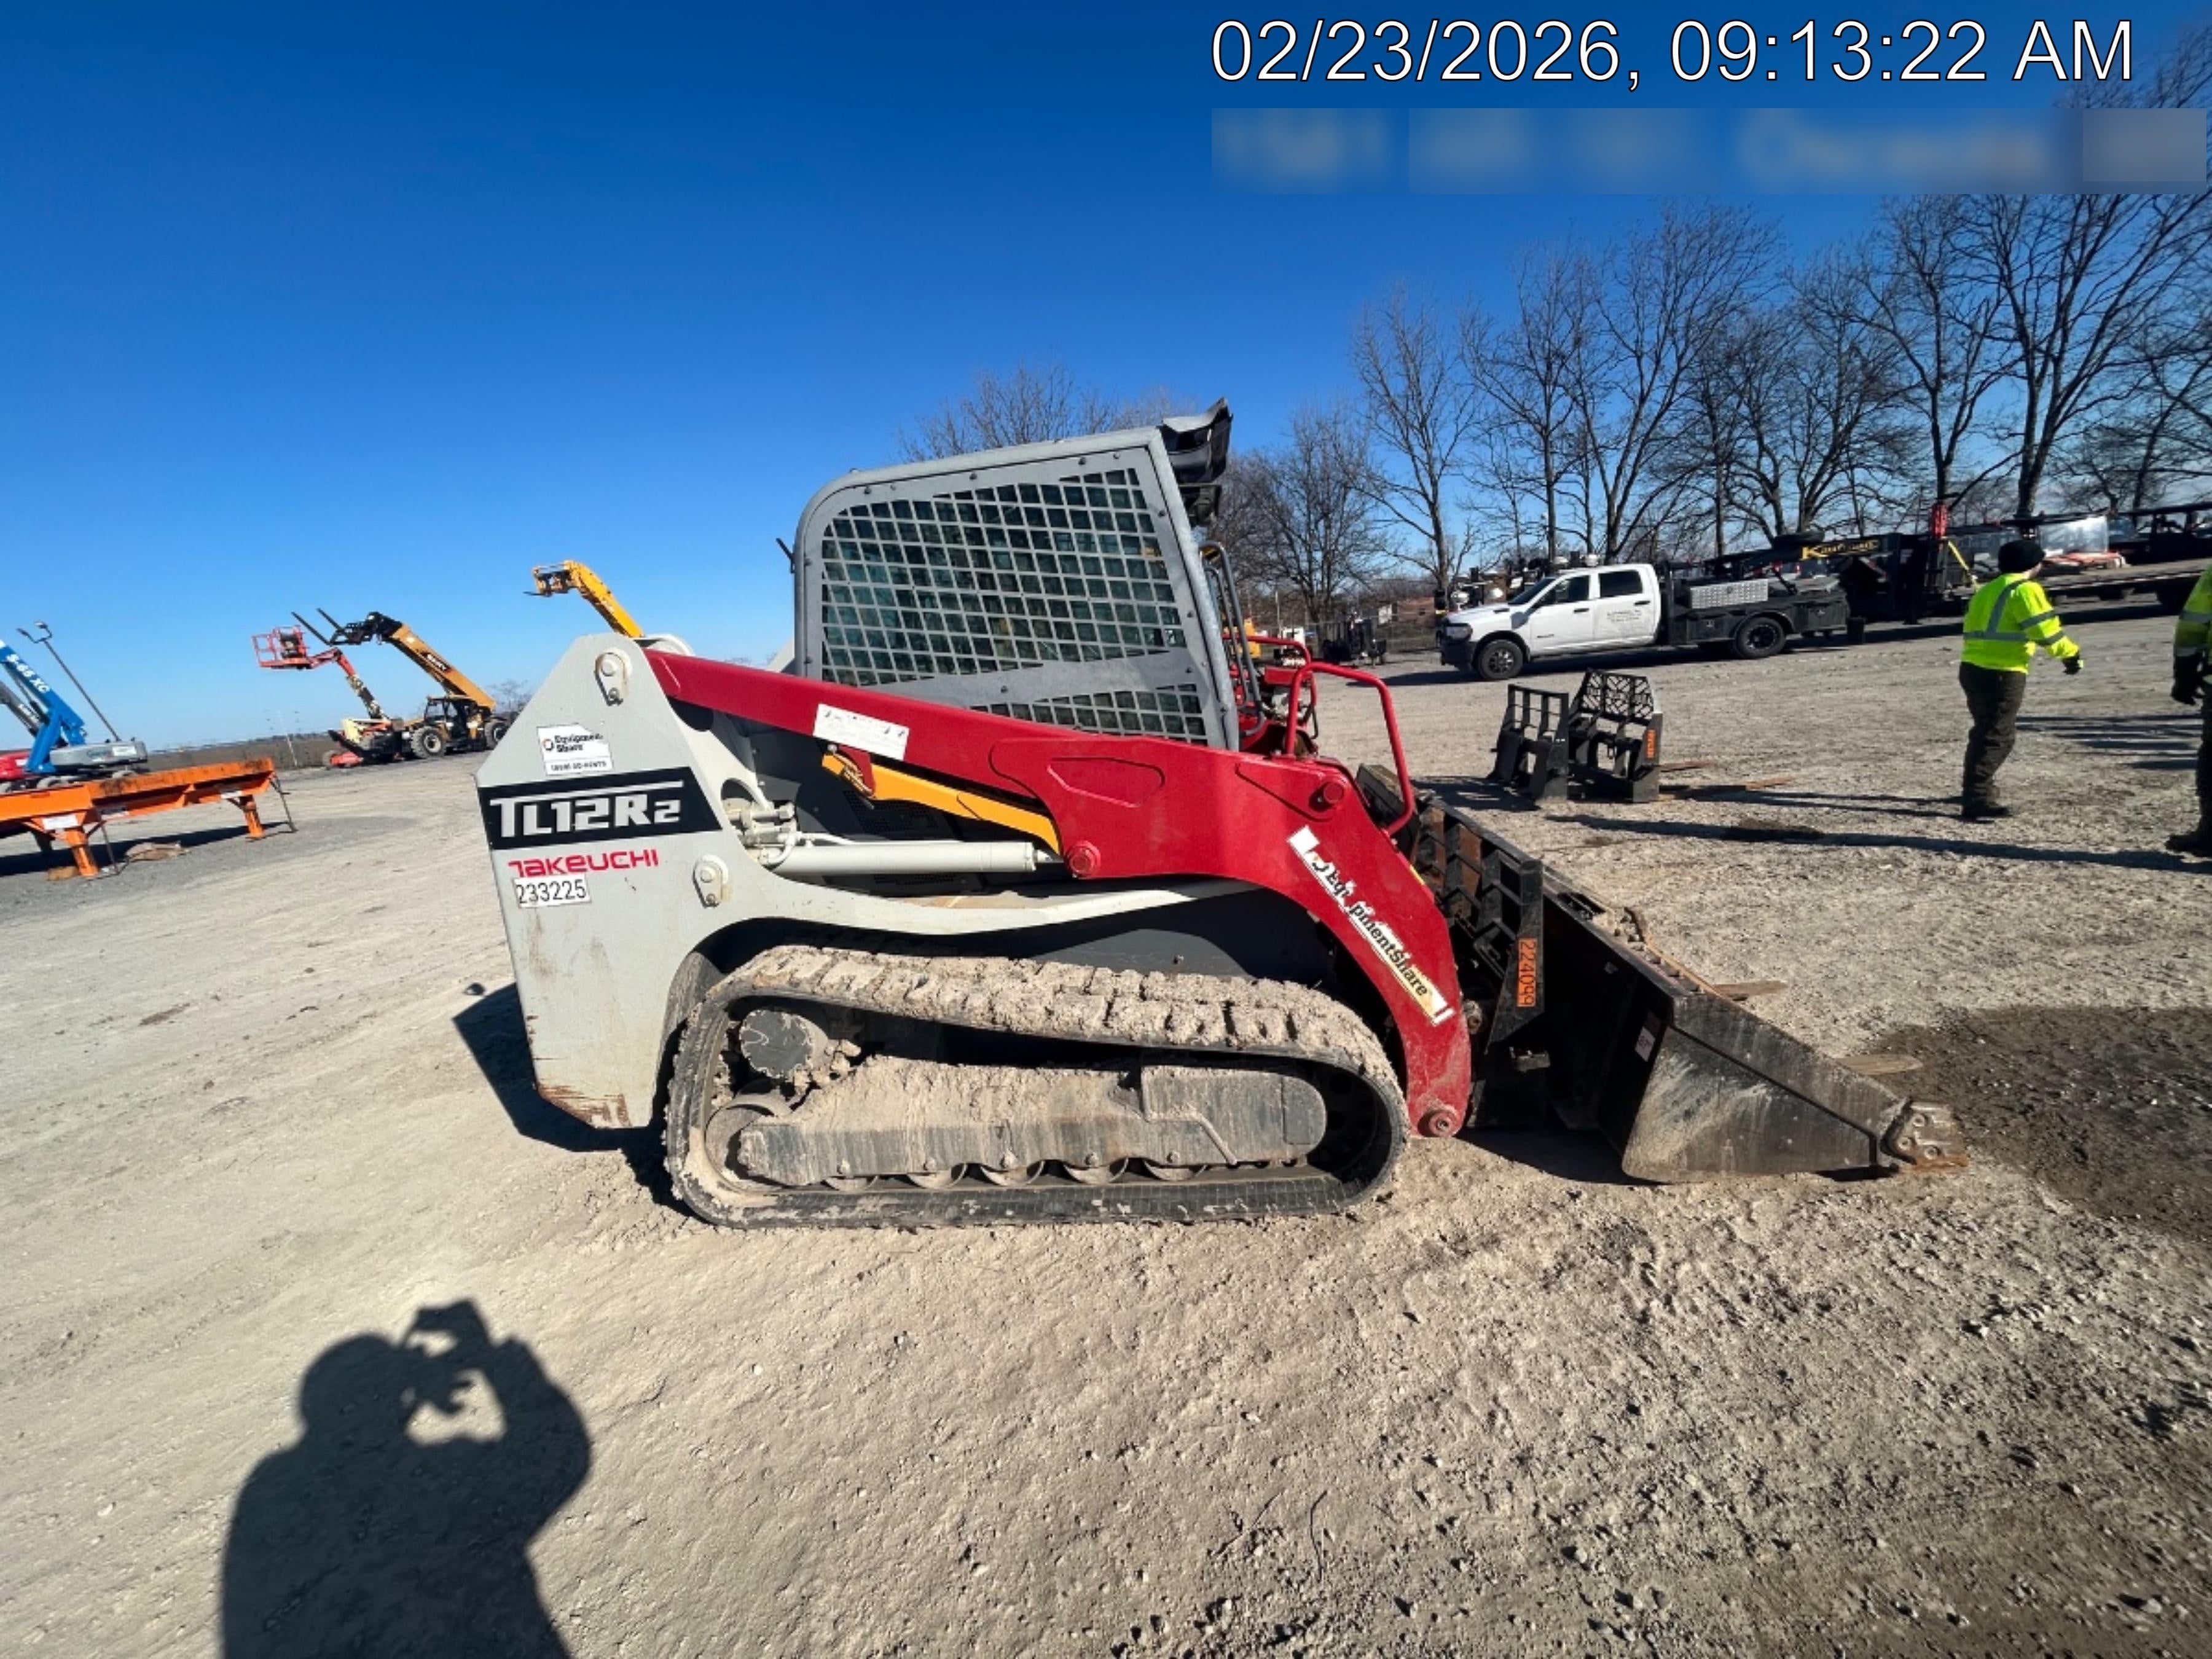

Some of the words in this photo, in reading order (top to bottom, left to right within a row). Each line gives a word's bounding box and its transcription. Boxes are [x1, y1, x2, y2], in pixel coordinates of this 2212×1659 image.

[6, 653, 36, 678] S-65
[29, 677, 50, 694] XC
[516, 879, 586, 904] 233225
[1520, 941, 1535, 1005] 224099
